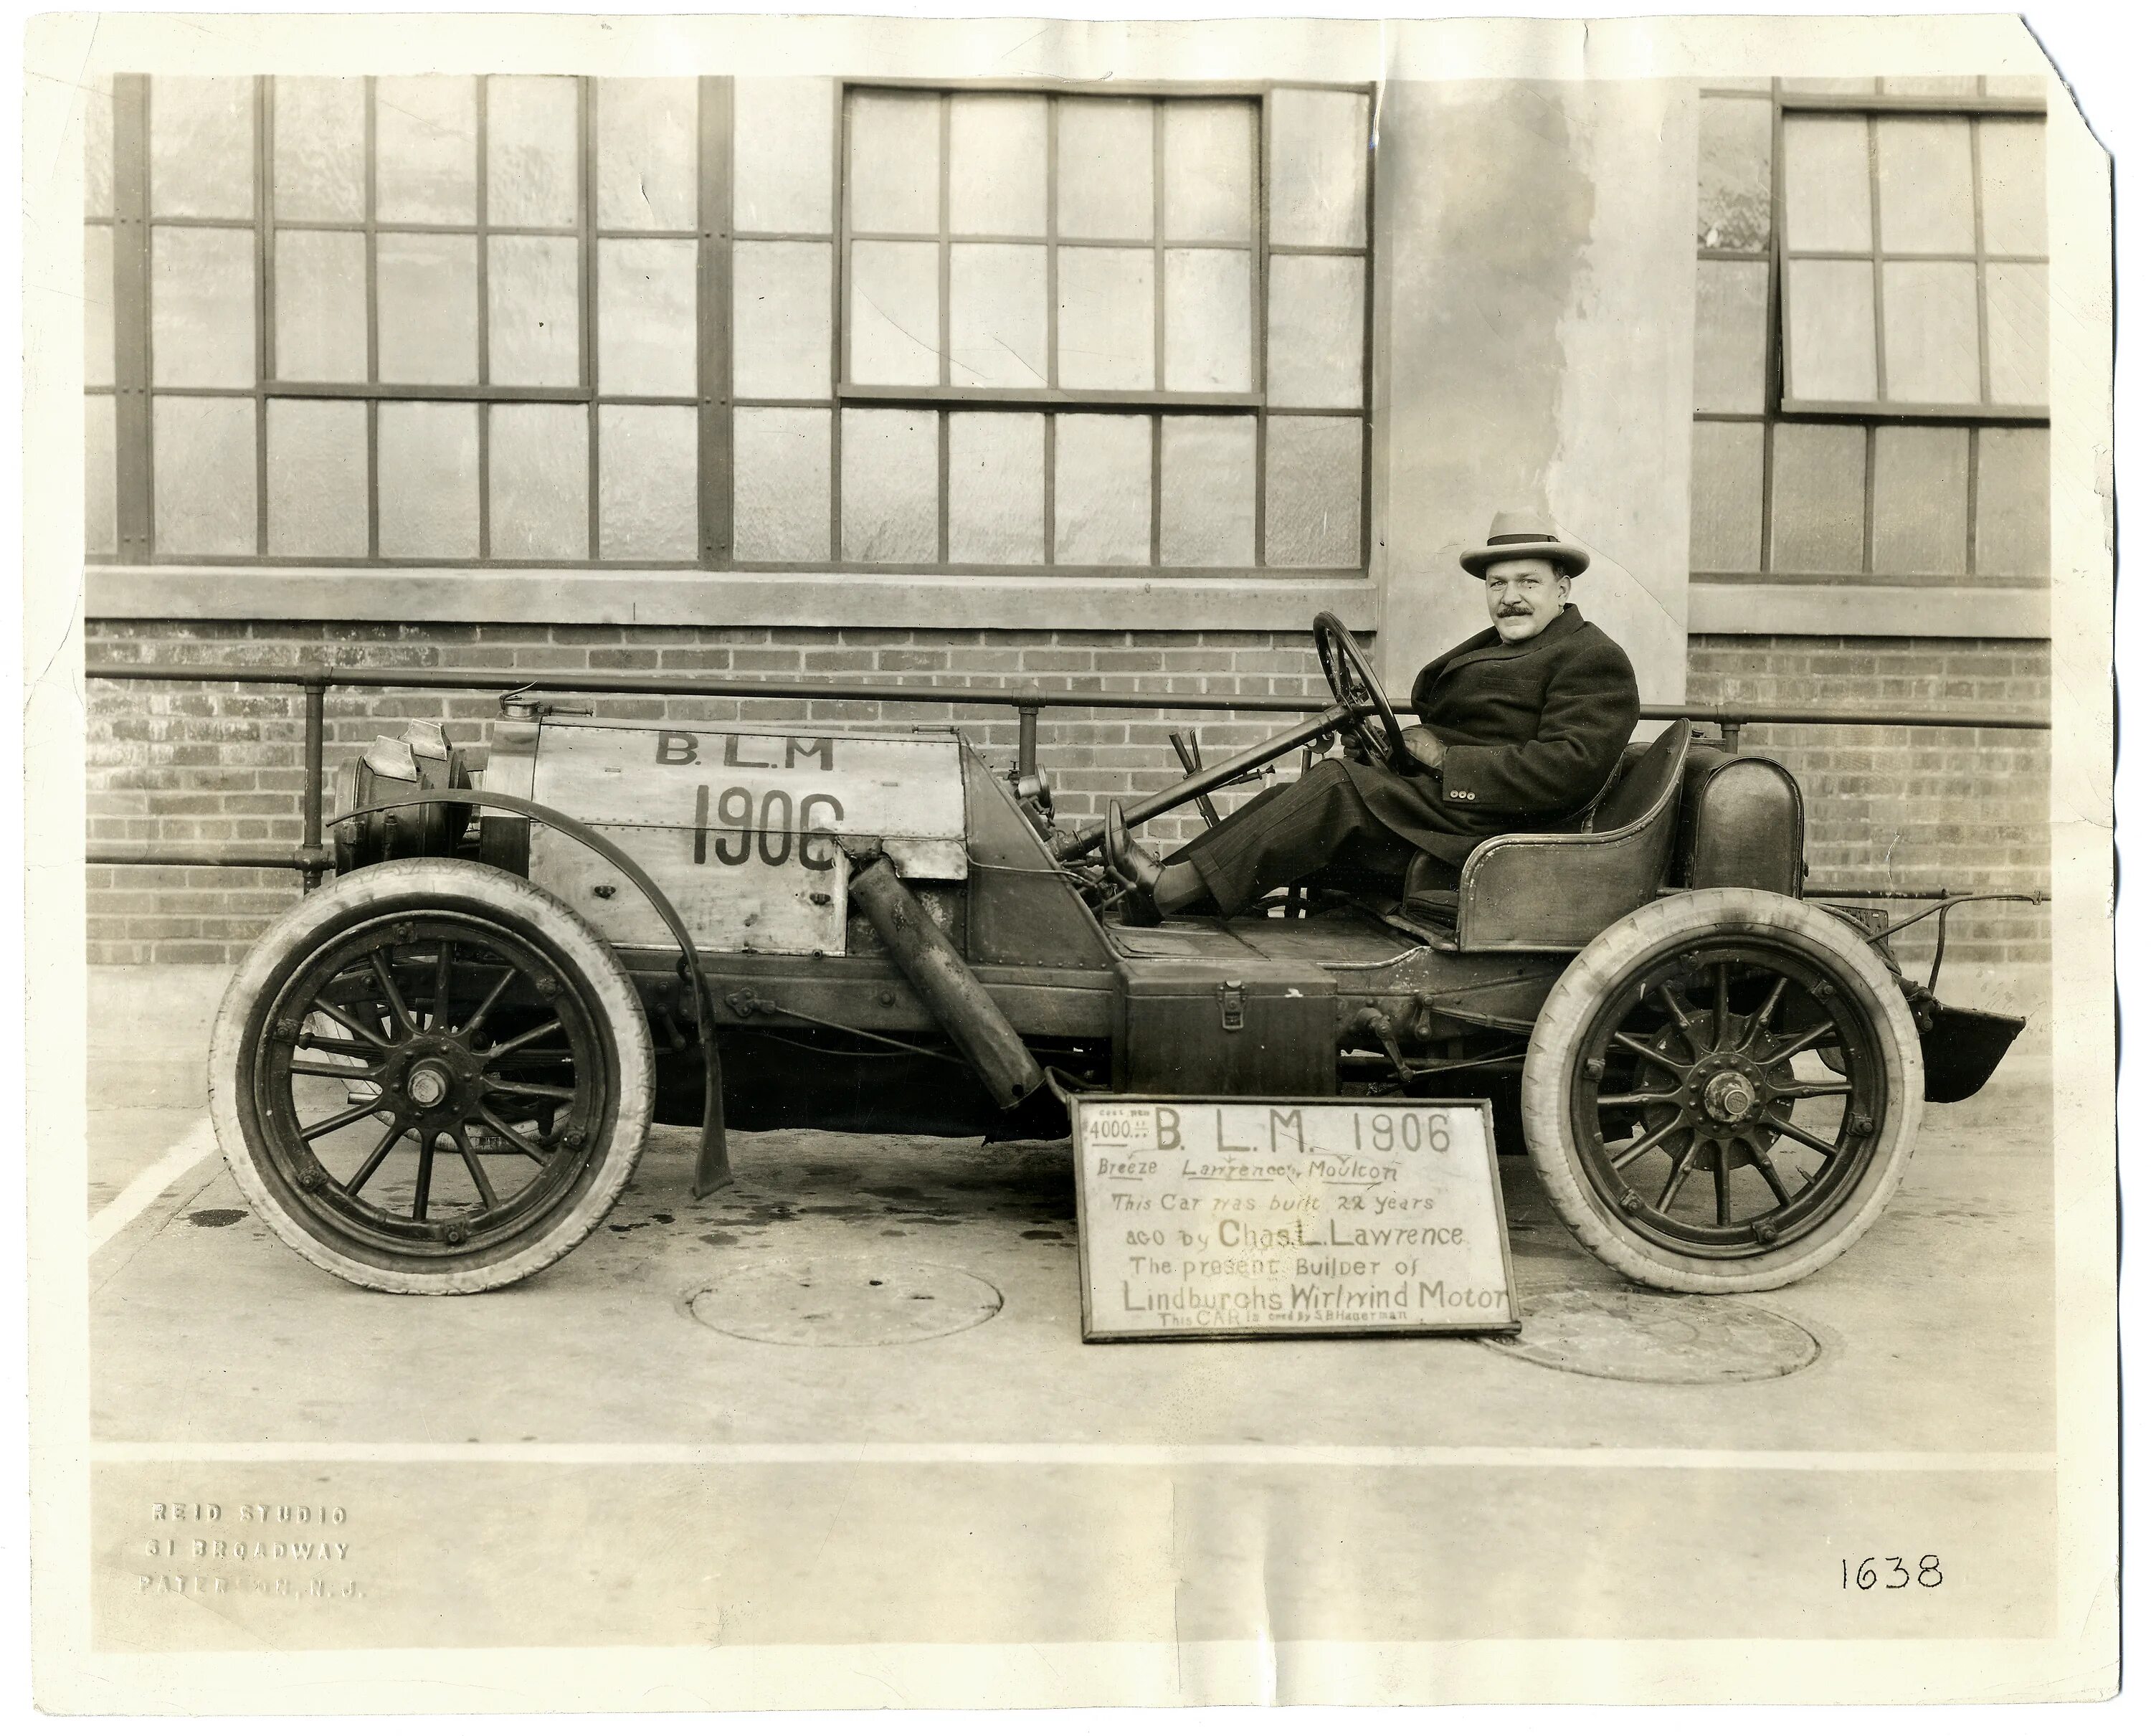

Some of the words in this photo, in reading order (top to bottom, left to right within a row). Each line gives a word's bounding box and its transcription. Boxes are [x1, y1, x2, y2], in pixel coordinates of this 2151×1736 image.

[694, 784, 845, 871] 1906
[1354, 1112, 1450, 1152] 1906
[1097, 1158, 1157, 1176] Breeze
[1309, 1161, 1397, 1182] Moulton
[1111, 1192, 1152, 1210] This
[1161, 1194, 1201, 1210] Car
[1338, 1195, 1365, 1210] 22
[1374, 1195, 1434, 1215] years
[1129, 1256, 1173, 1274] The
[1184, 1258, 1281, 1282] present
[1395, 1258, 1420, 1276] of
[1419, 1280, 1509, 1309] Motor
[1158, 1312, 1192, 1327] This
